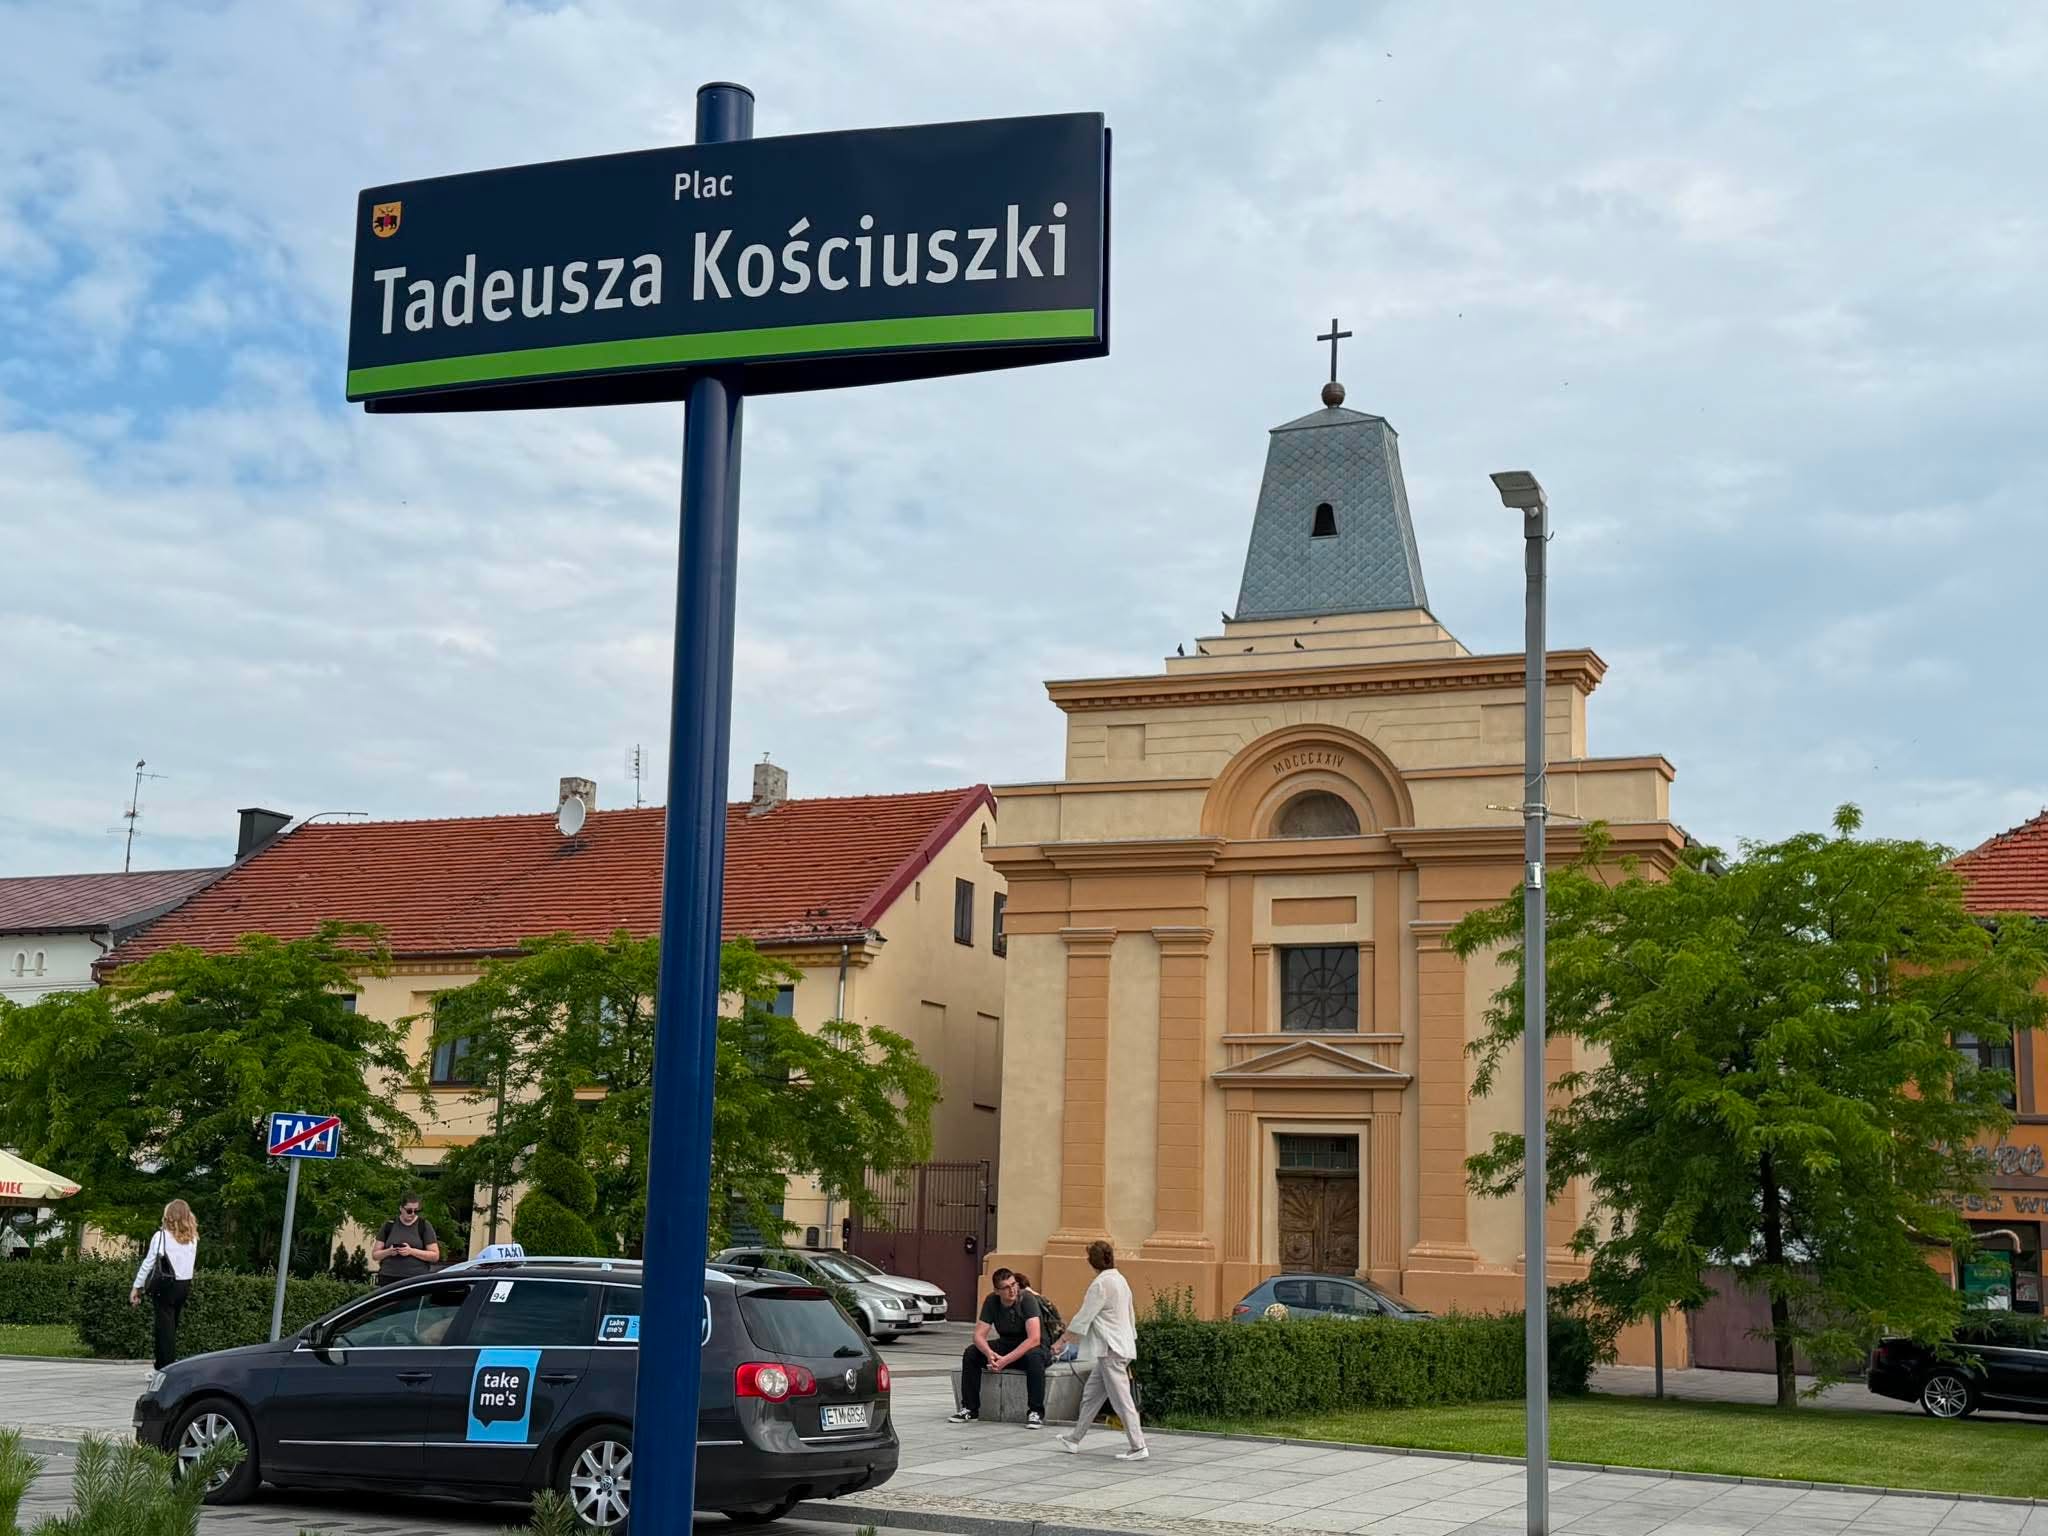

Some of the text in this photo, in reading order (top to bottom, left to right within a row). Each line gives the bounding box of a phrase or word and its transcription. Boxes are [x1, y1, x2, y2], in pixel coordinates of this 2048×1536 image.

[674, 168, 733, 200] Plac
[374, 202, 1068, 335] Tadeusza Kościuszki
[1273, 752, 1345, 775] MDCCCXXIV
[276, 1119, 334, 1152] TAXI
[497, 1246, 523, 1258] TAXI
[492, 1292, 506, 1301] 94
[609, 1318, 625, 1326] take
[483, 1371, 519, 1388] take
[480, 1390, 517, 1406] me's
